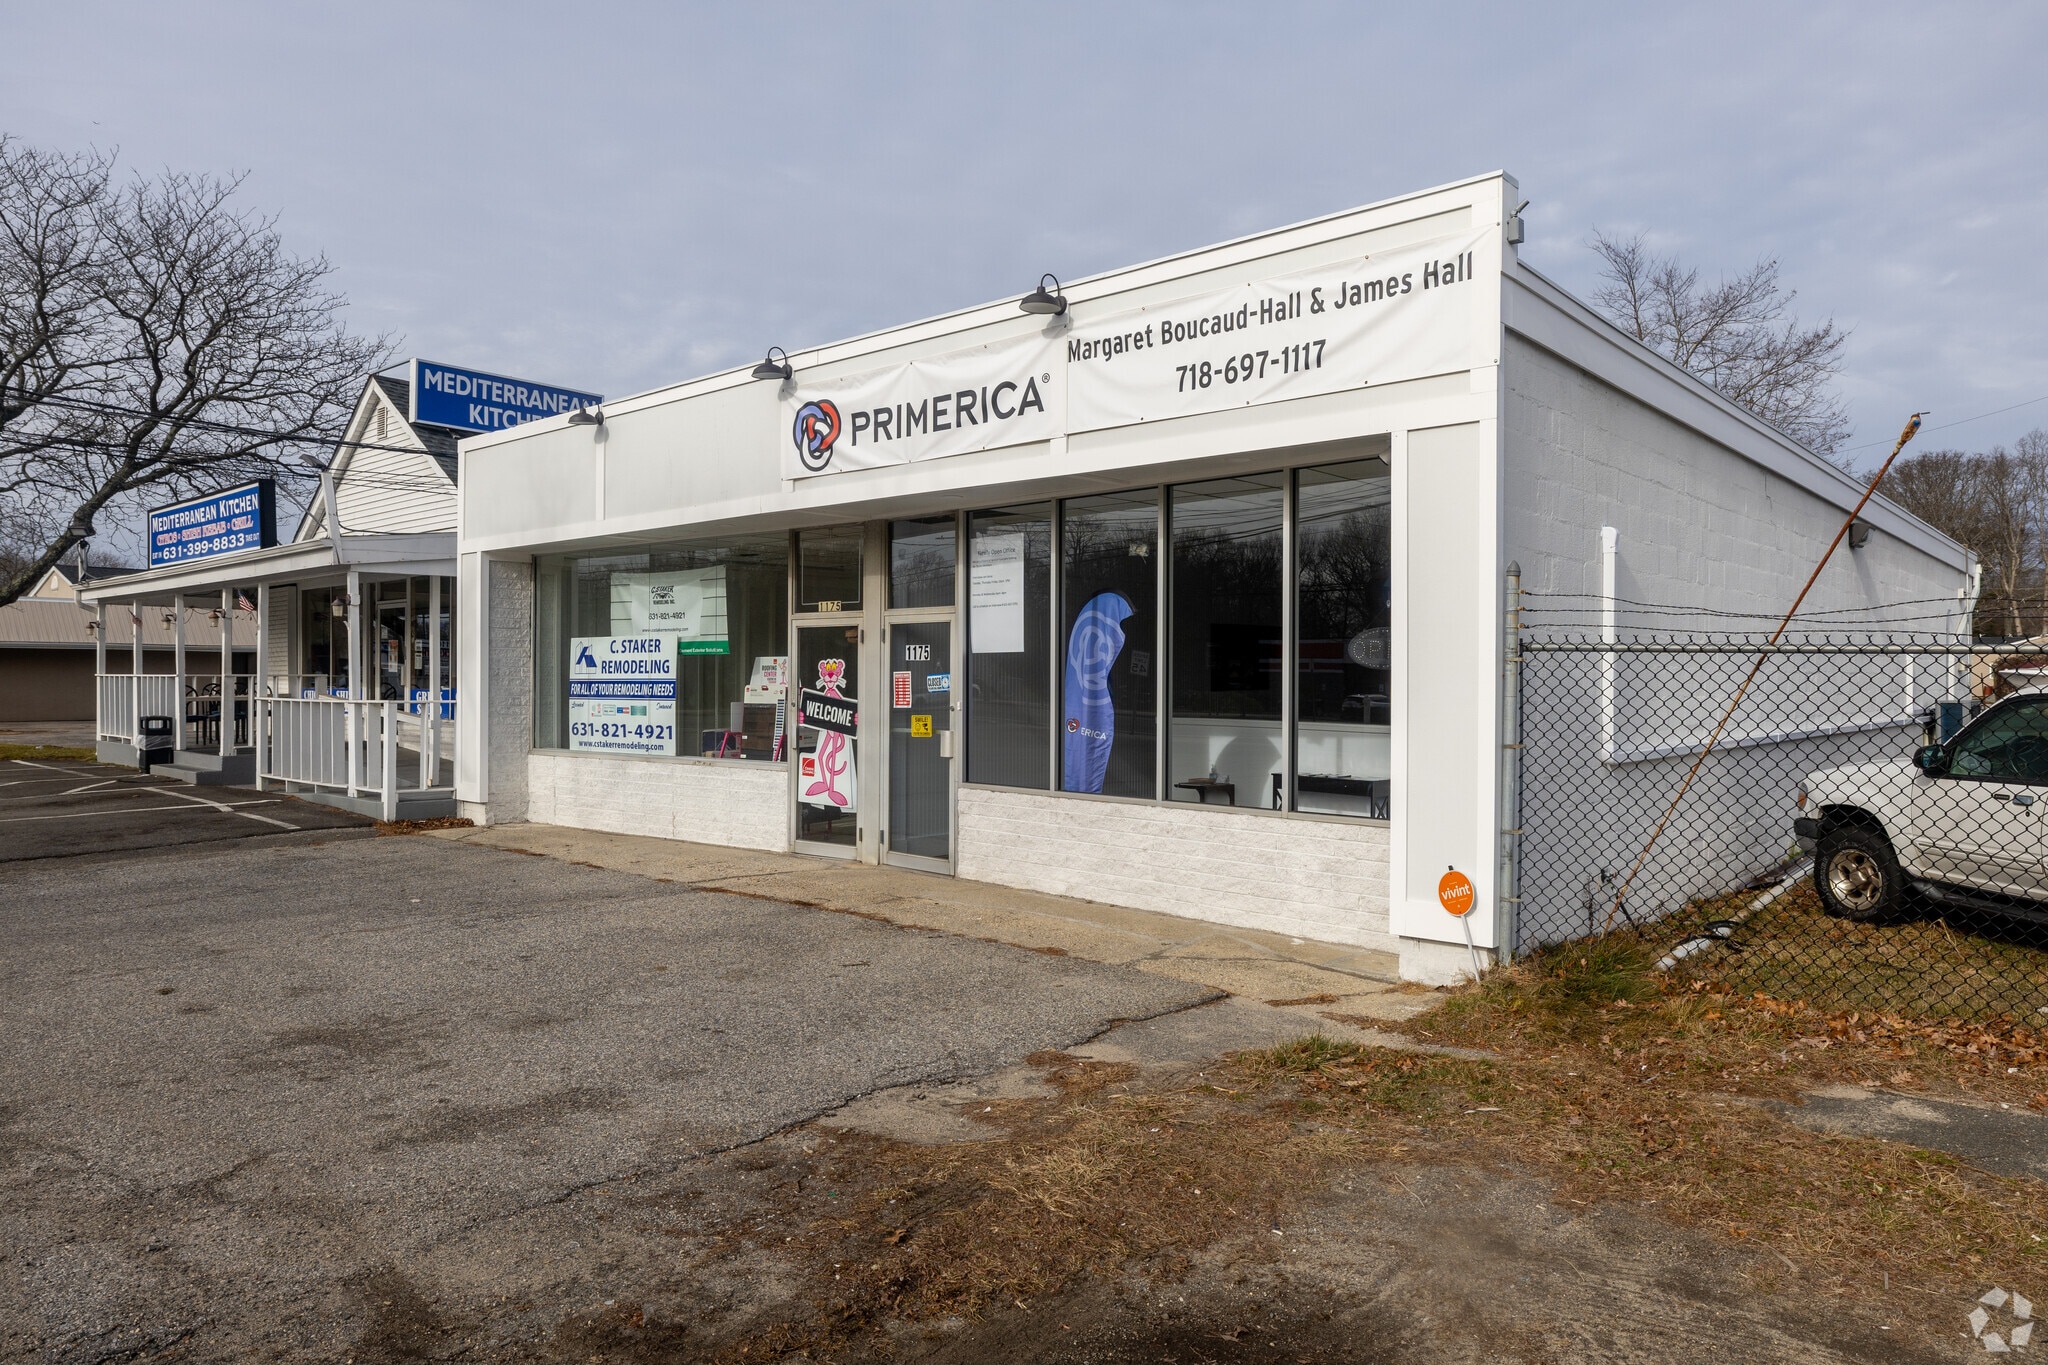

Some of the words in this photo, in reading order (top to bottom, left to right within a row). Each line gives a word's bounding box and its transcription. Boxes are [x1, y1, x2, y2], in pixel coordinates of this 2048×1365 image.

[1068, 324, 1153, 362] Margaret
[1161, 292, 1301, 345] Boucaud-Hall
[1310, 287, 1325, 315] &
[1334, 272, 1412, 309] James
[1424, 251, 1473, 290] Hall
[1176, 339, 1327, 392] 718-697-1117
[469, 403, 546, 429] KITCH
[152, 504, 217, 533] MEDITERRANEAN
[219, 493, 259, 518] KITCHEN
[163, 533, 245, 560] 631-399-8833
[819, 601, 841, 611] 1175
[621, 639, 661, 653] STAKER
[907, 645, 930, 660] 1175
[1353, 640, 1391, 660] OP
[601, 659, 670, 674] REMODELING
[571, 683, 581, 695] FOR
[581, 683, 590, 695] ALL
[590, 683, 598, 695] OF
[598, 683, 613, 695] YOUR
[613, 683, 652, 696] REMODELING
[652, 683, 674, 696] NEEDS
[806, 700, 853, 727] WELCOME
[571, 722, 673, 740] 631-821-4921
[579, 740, 664, 752] www.cstakerremodeling.com
[1441, 883, 1471, 900] vivint
